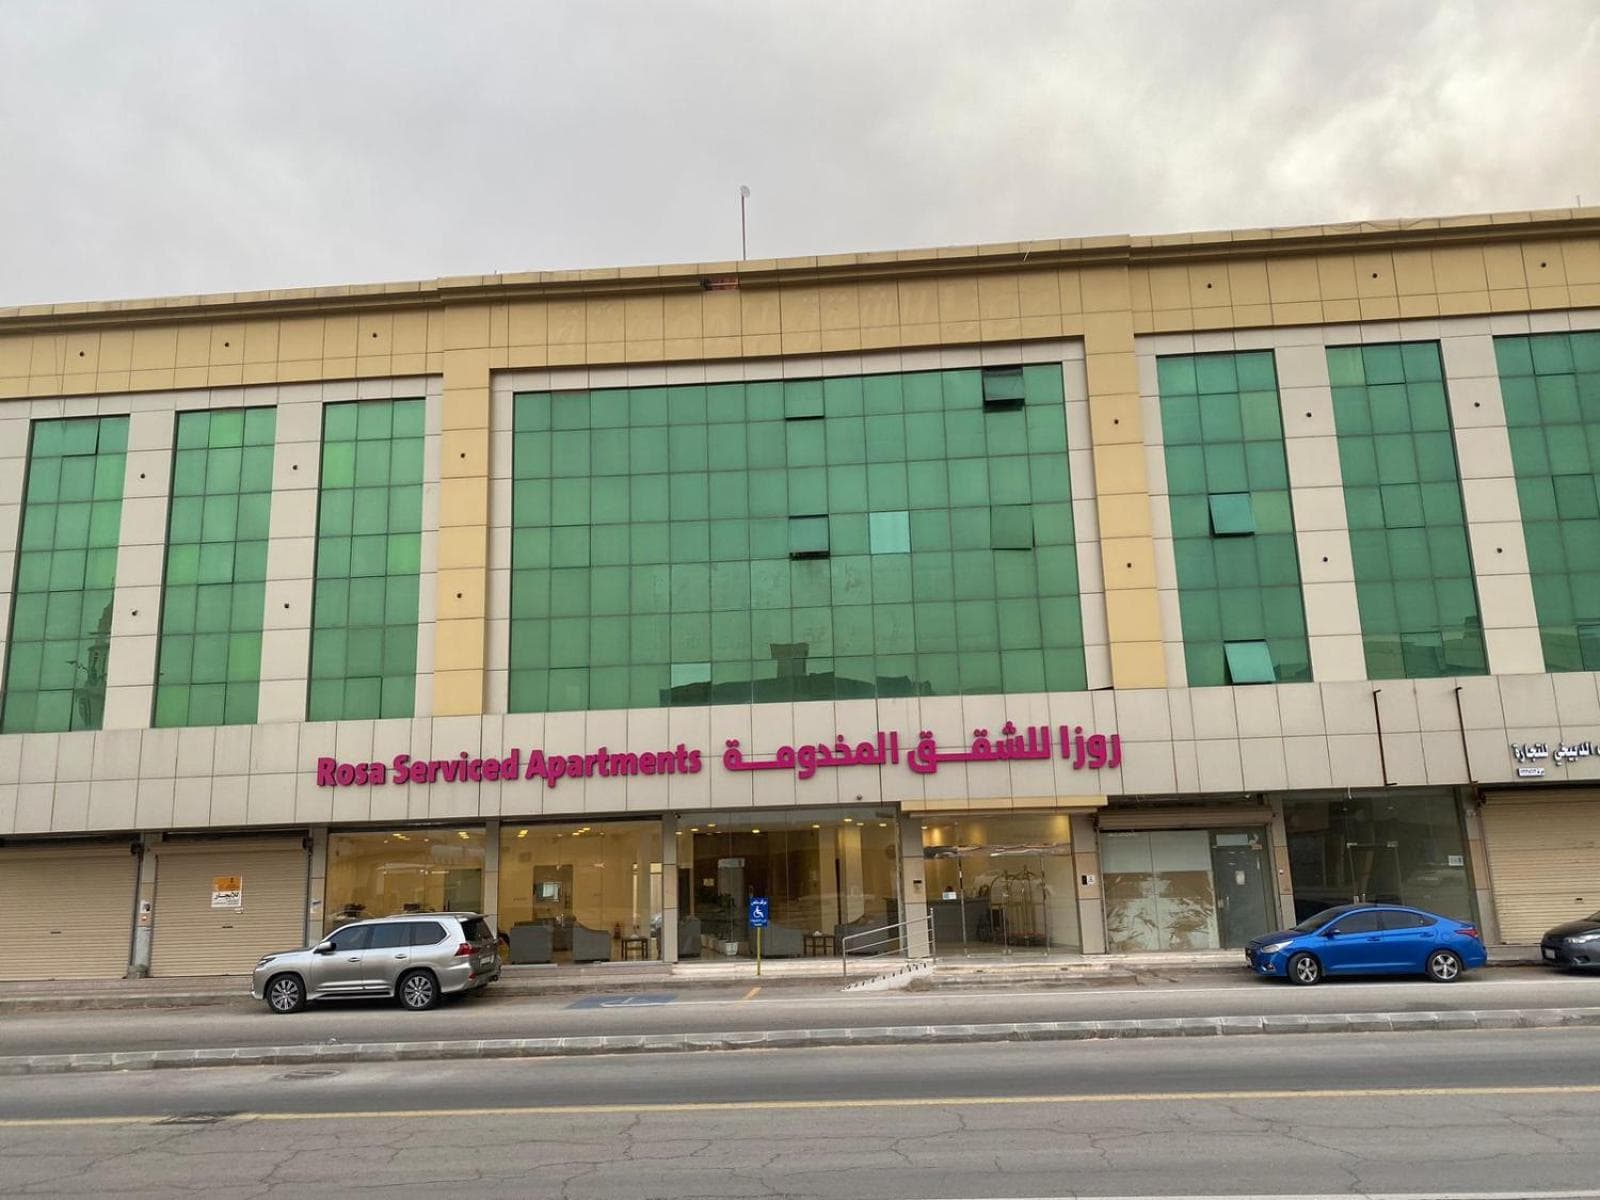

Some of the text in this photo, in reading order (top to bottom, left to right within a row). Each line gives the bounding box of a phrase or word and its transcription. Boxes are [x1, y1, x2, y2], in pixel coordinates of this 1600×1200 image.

[316, 743, 702, 788] Rosa Serviced Apartments
[722, 721, 1122, 780] روزا للشقق المخدومة
